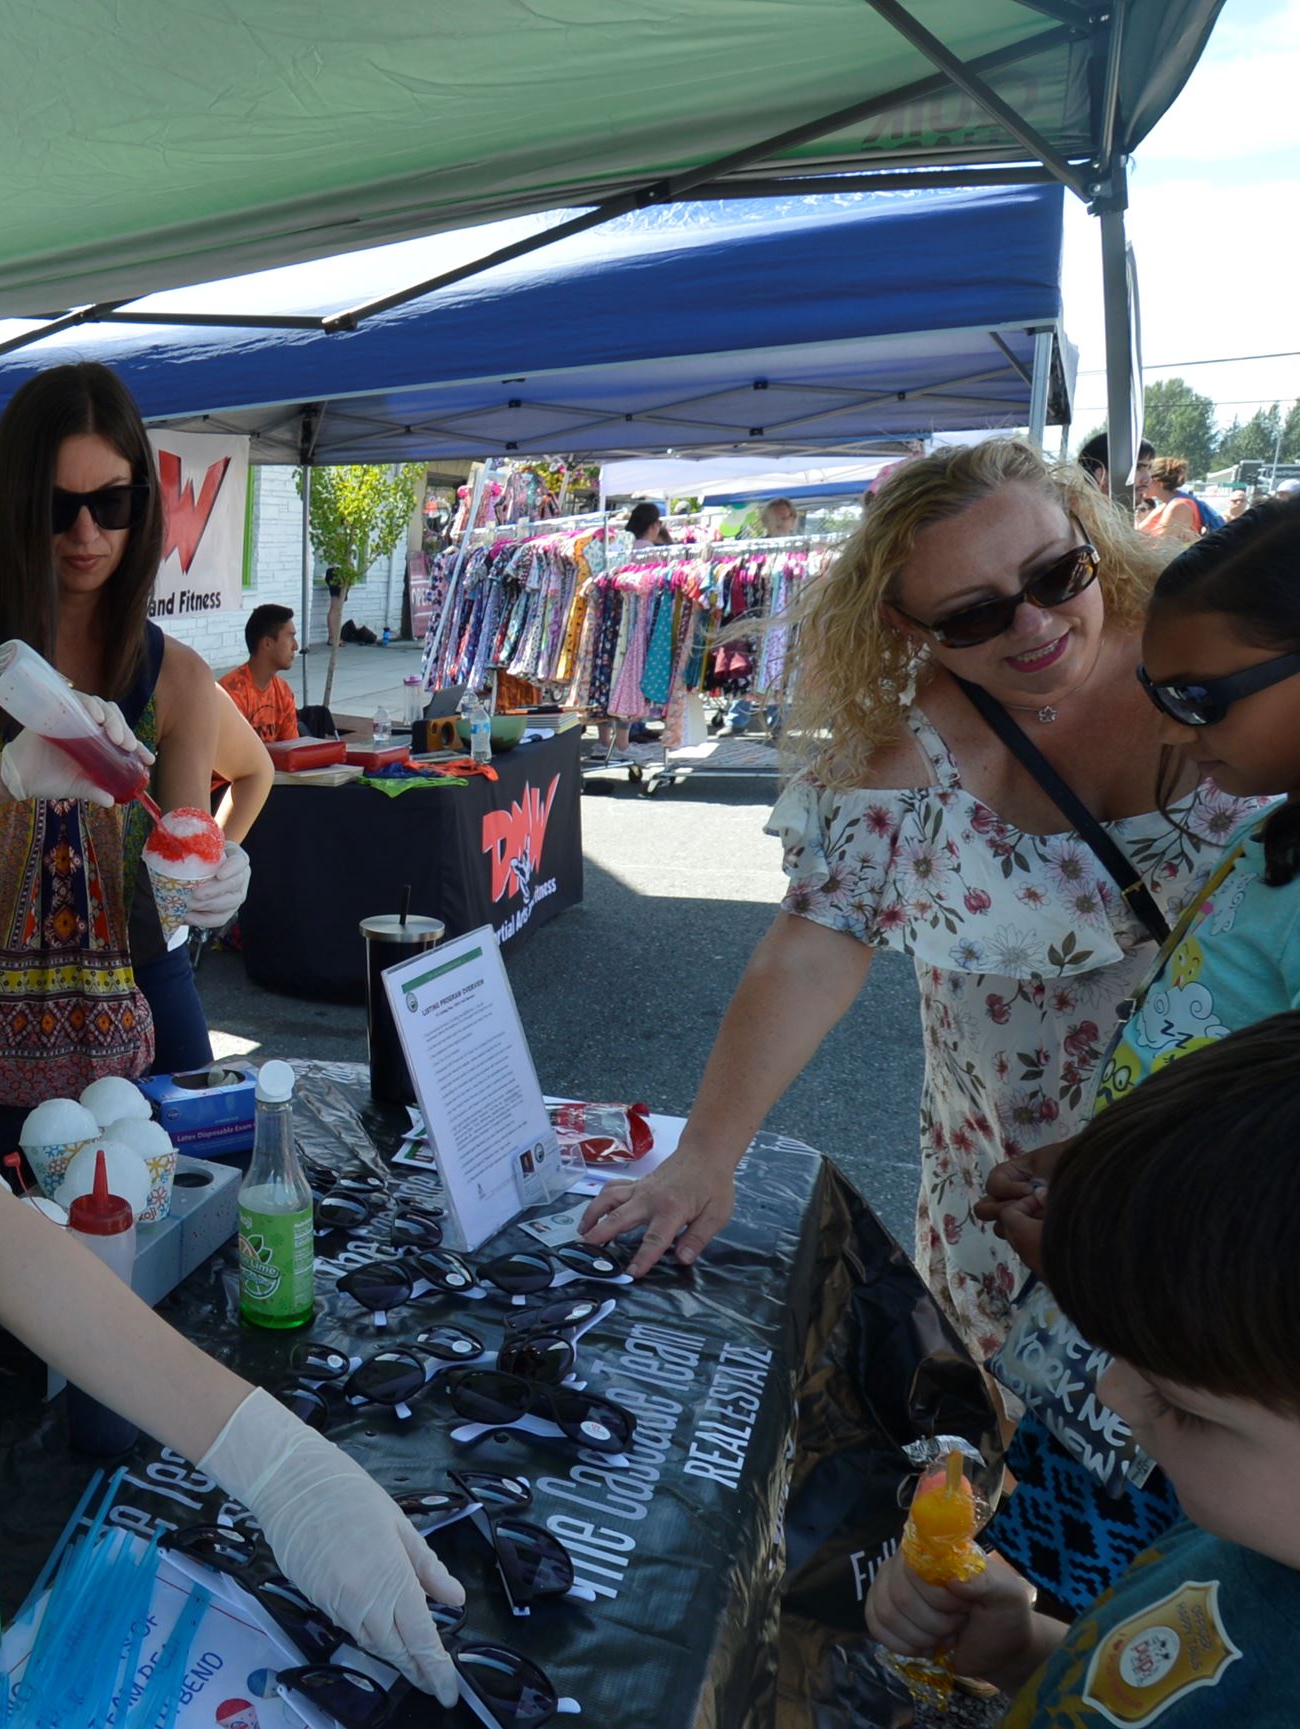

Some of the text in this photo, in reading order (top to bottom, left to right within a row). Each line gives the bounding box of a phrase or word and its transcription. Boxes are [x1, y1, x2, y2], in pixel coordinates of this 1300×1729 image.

[179, 588, 222, 614] Fitness
[197, 1126, 234, 1140] Disposable
[590, 1323, 707, 1392] Team
[1076, 1392, 1133, 1447] NE
[177, 1650, 225, 1706] BEND
